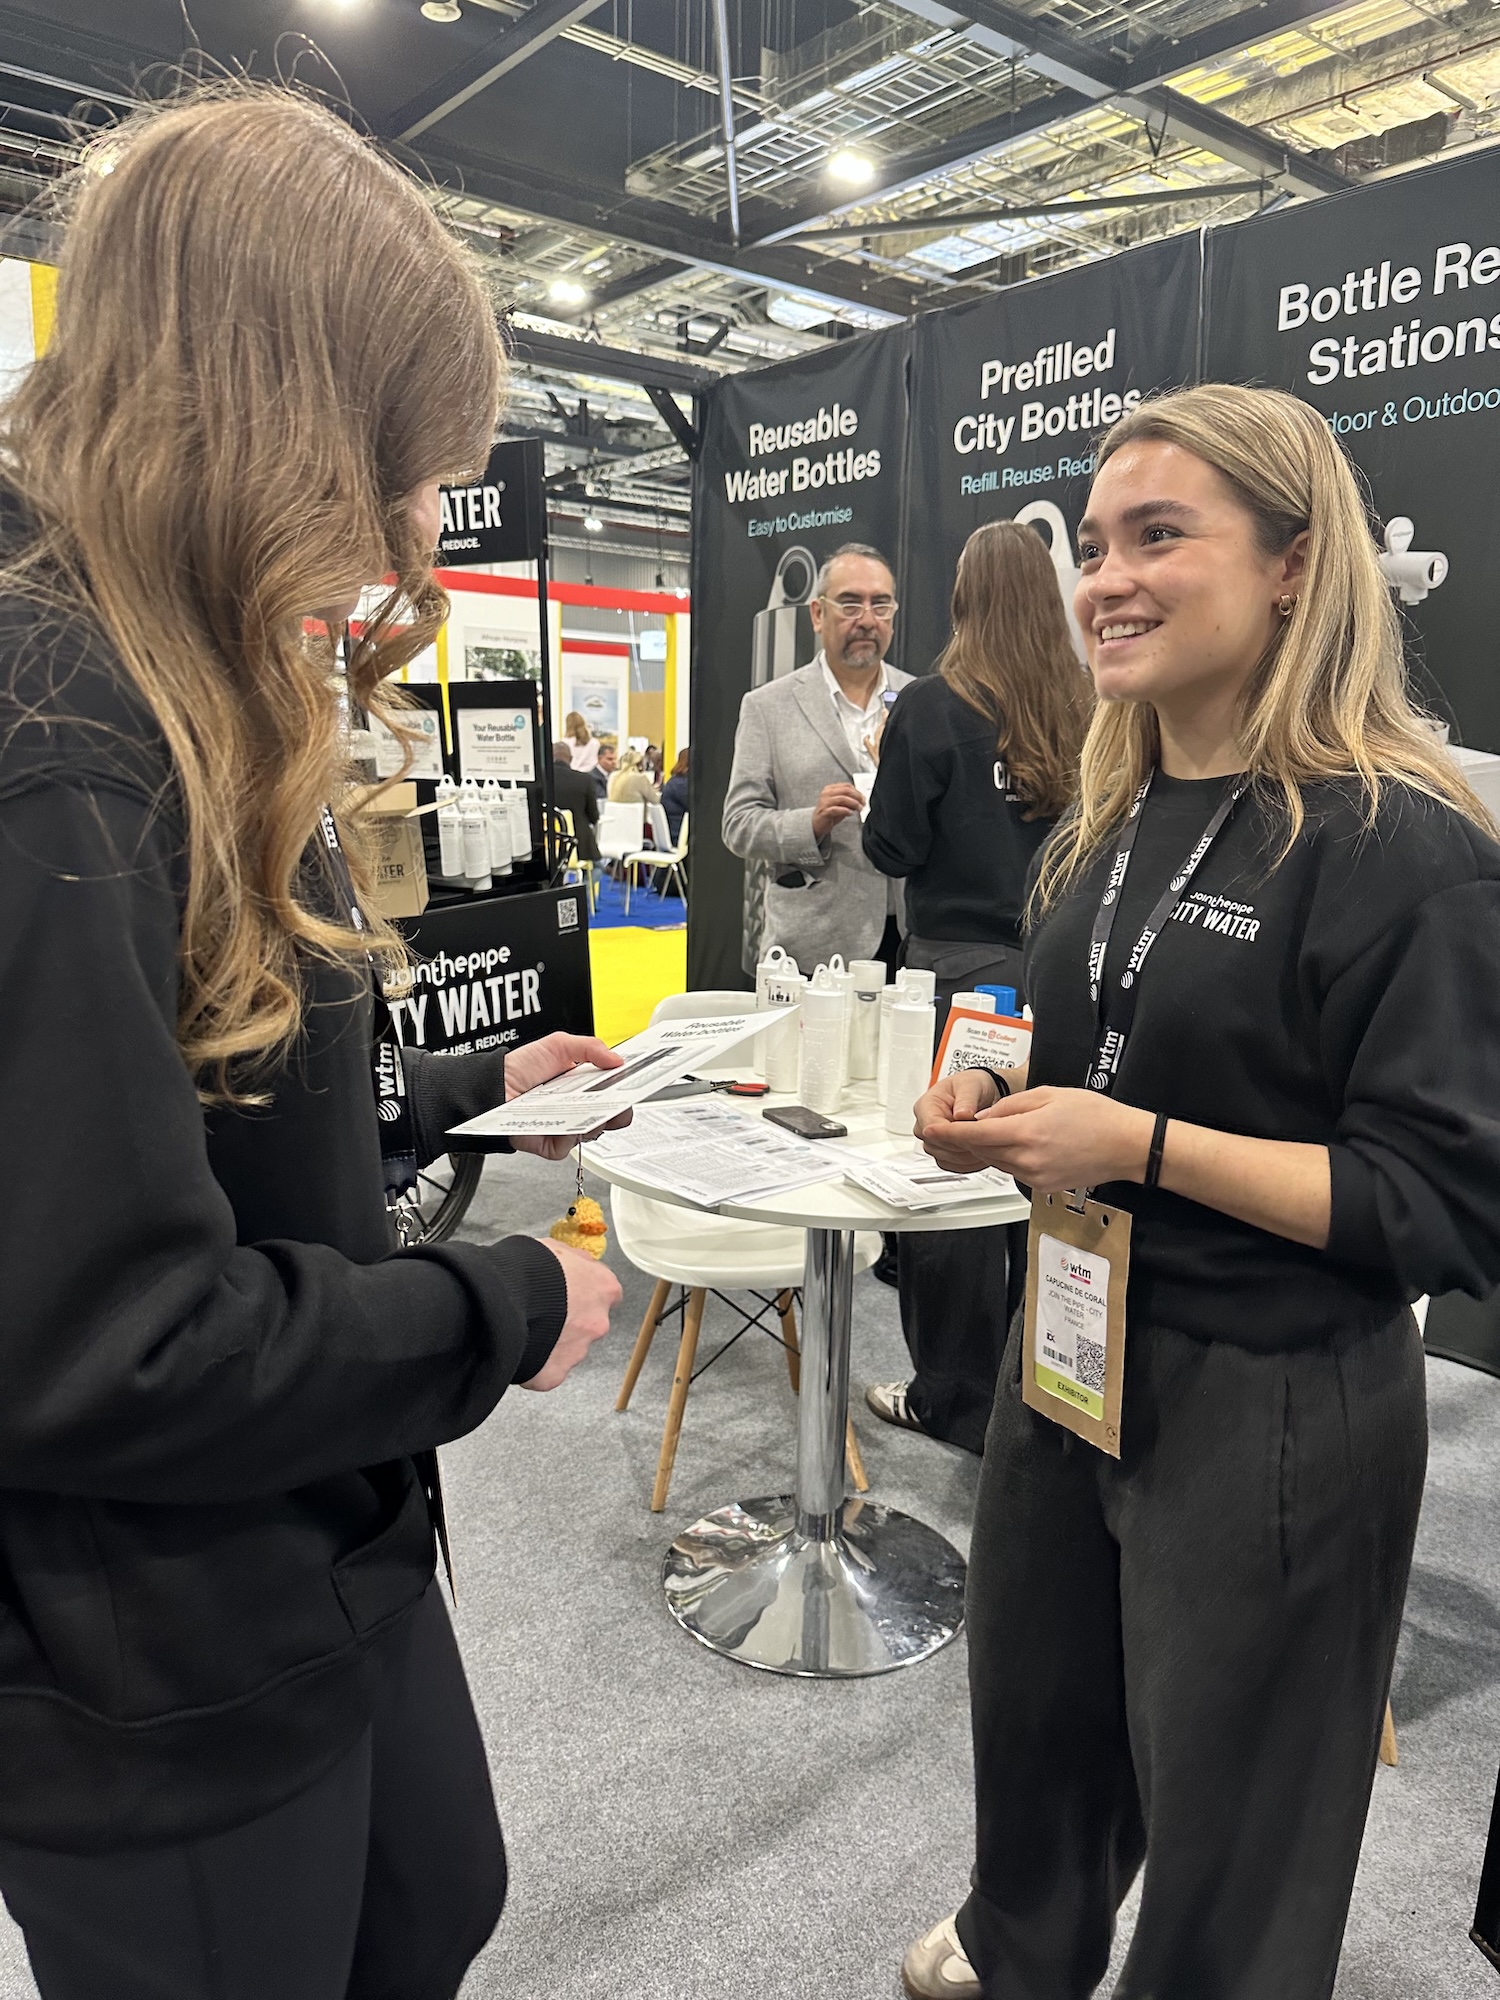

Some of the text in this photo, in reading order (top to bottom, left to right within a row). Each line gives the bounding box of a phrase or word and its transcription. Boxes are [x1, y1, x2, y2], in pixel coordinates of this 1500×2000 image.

[1278, 242, 1500, 332] Bottle Re
[980, 328, 1117, 400] Prefilled
[749, 403, 858, 457] Reusable
[953, 387, 1142, 454] City Bottles
[1327, 388, 1500, 435] door & Outdoo
[725, 447, 881, 503] Water Bottles
[961, 454, 1097, 496] Refill. Reuse. Red
[440, 485, 502, 532] ATER
[748, 505, 853, 538] Easy to Customise
[442, 537, 481, 551] REDUCE.
[473, 722, 517, 732] Your Reusable
[476, 733, 516, 742] Water Bottle
[1108, 851, 1126, 889] wtm
[1181, 835, 1210, 876] wtm
[1169, 901, 1260, 942] ITY WATER
[1088, 941, 1101, 982] wtm
[1128, 929, 1152, 969] wtm
[386, 968, 541, 1048] TY WATER
[475, 1029, 519, 1050] REDUCE.
[967, 1027, 980, 1036] Scan
[1098, 1030, 1119, 1070] wtm
[375, 1042, 395, 1096] wtm
[1045, 1274, 1074, 1294] CAPUCINE
[1074, 1287, 1084, 1298] DE
[1084, 1291, 1107, 1307] CORAL
[1069, 1262, 1091, 1280] wtm
[1048, 1289, 1060, 1301] JOIN
[1060, 1294, 1072, 1306] THE
[1073, 1299, 1085, 1311] PIPE
[1088, 1306, 1104, 1319] CITY
[1064, 1305, 1085, 1319] WATER
[1064, 1315, 1085, 1330] FRANCE
[1057, 1381, 1089, 1405] EXHIBITOR
